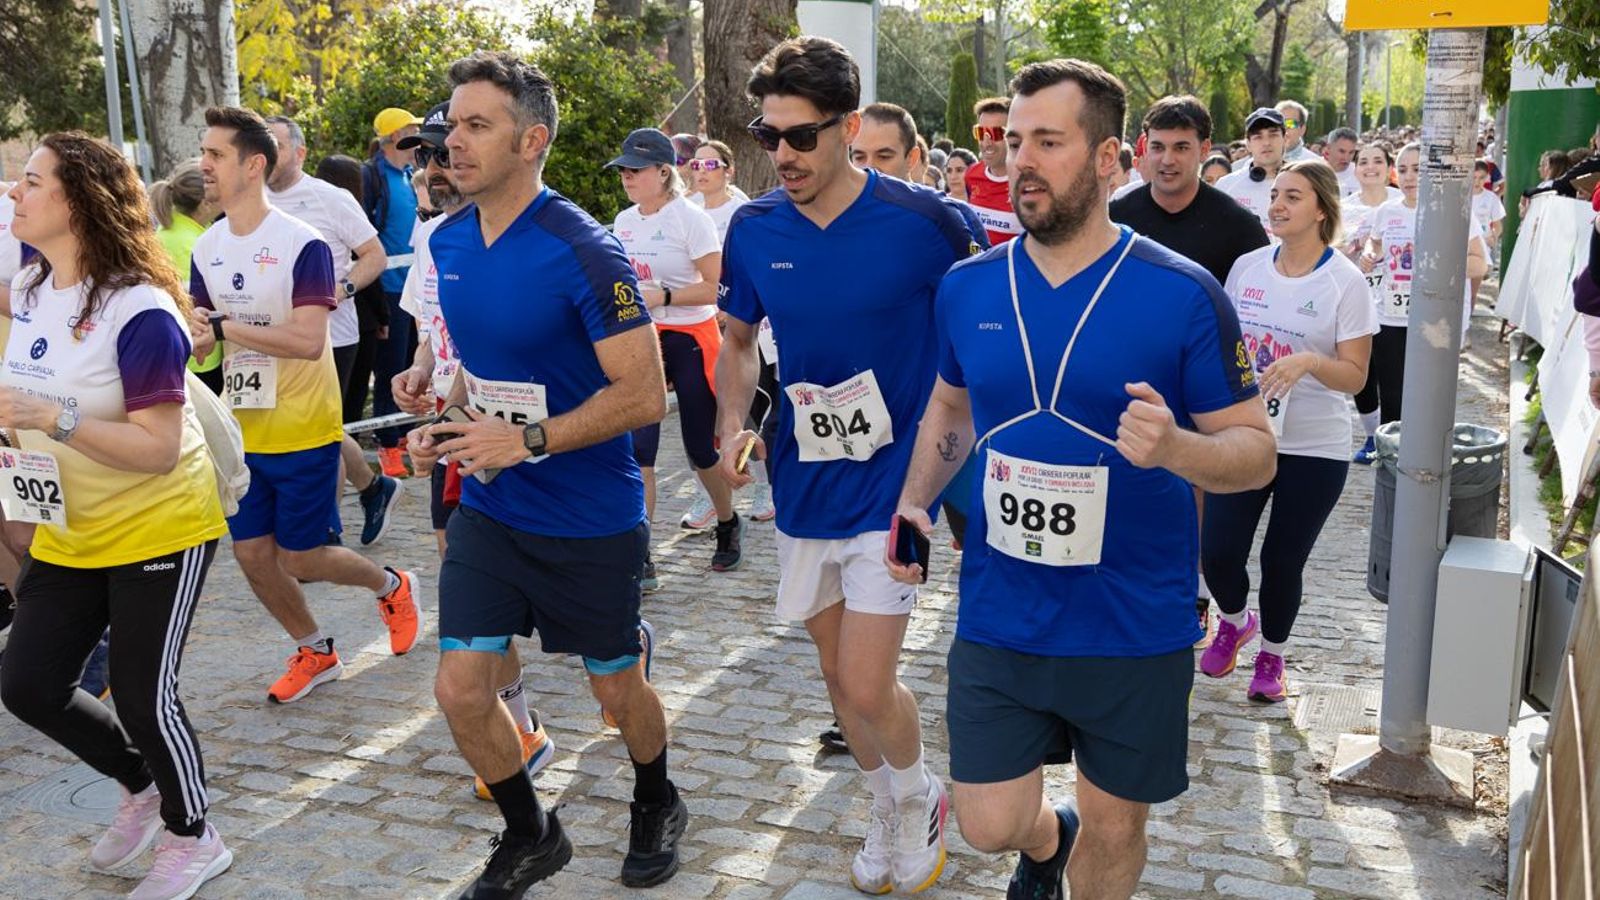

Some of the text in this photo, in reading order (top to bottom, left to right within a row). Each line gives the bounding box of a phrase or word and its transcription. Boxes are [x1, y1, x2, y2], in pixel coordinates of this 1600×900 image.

[1242, 287, 1265, 300] XXVII
[979, 322, 1003, 330] KIPSTA
[226, 371, 262, 394] 904
[810, 408, 872, 438] 804
[13, 476, 63, 505] 902
[1000, 492, 1076, 536] 988
[1022, 532, 1045, 542] ISMAEL
[143, 563, 176, 571] adidas
